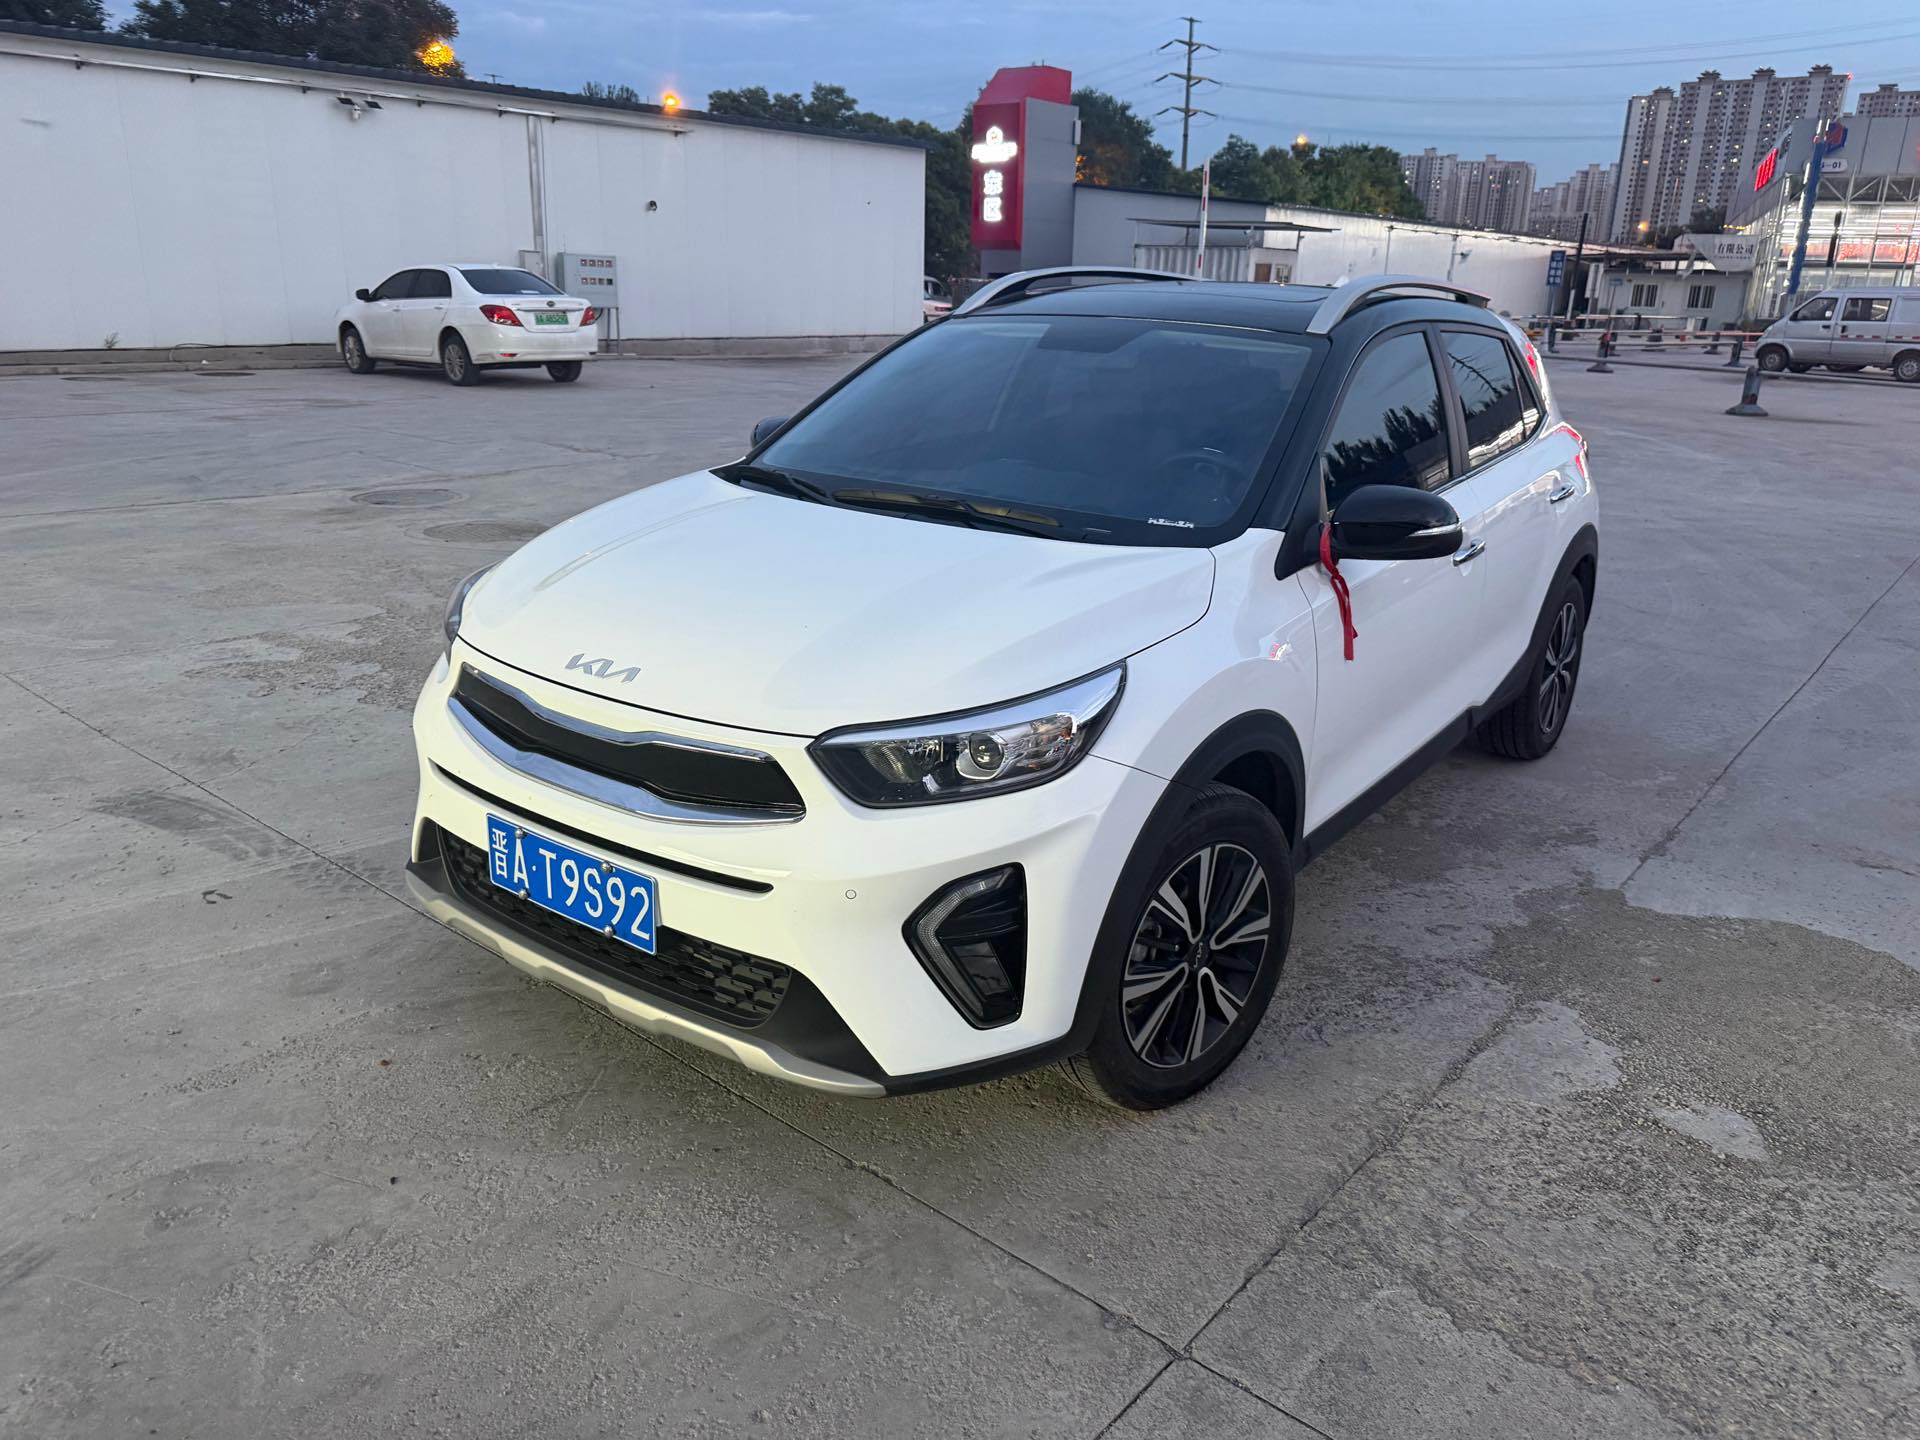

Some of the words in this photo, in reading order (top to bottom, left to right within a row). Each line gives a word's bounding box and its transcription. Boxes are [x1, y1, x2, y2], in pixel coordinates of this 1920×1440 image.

[1717, 243, 1754, 256] 有限公司
[565, 653, 641, 683] KIA
